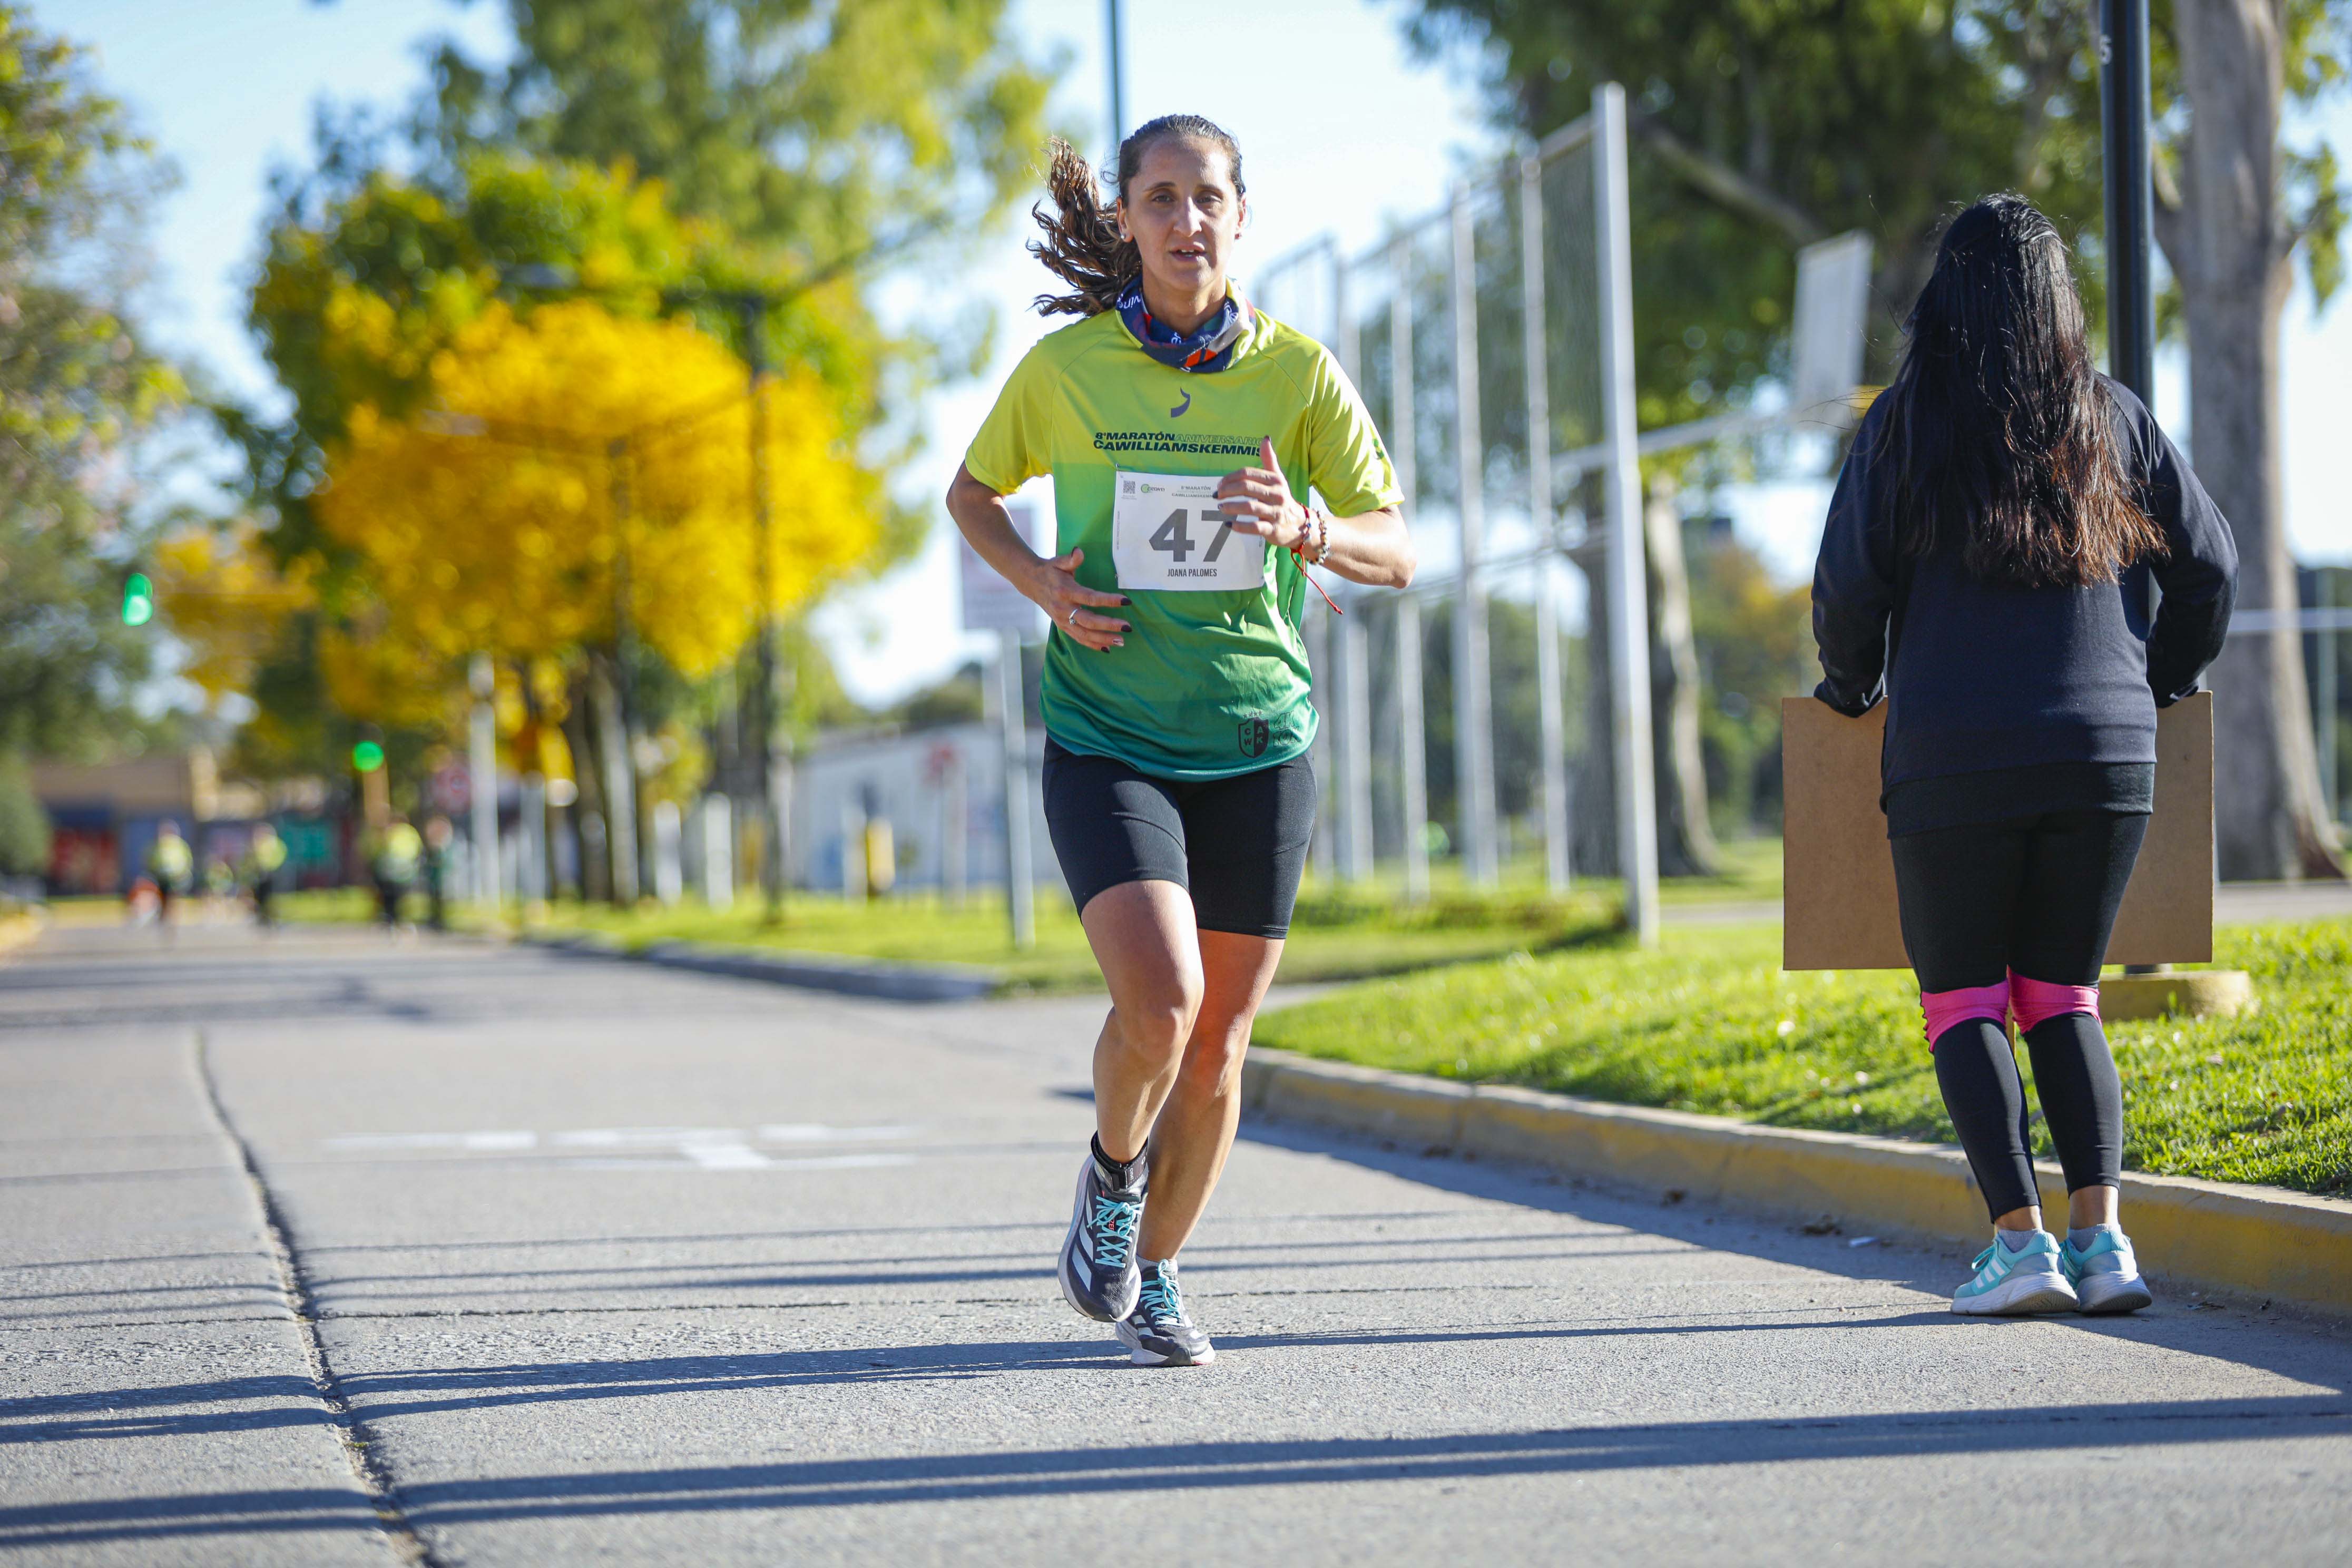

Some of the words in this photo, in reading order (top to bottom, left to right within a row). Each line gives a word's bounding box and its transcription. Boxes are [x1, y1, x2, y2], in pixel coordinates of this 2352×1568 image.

[1149, 508, 1238, 562] 47
[1168, 569, 1187, 577] JOANA
[1189, 569, 1217, 577] PALOMES
[1274, 711, 1295, 730] 4K
